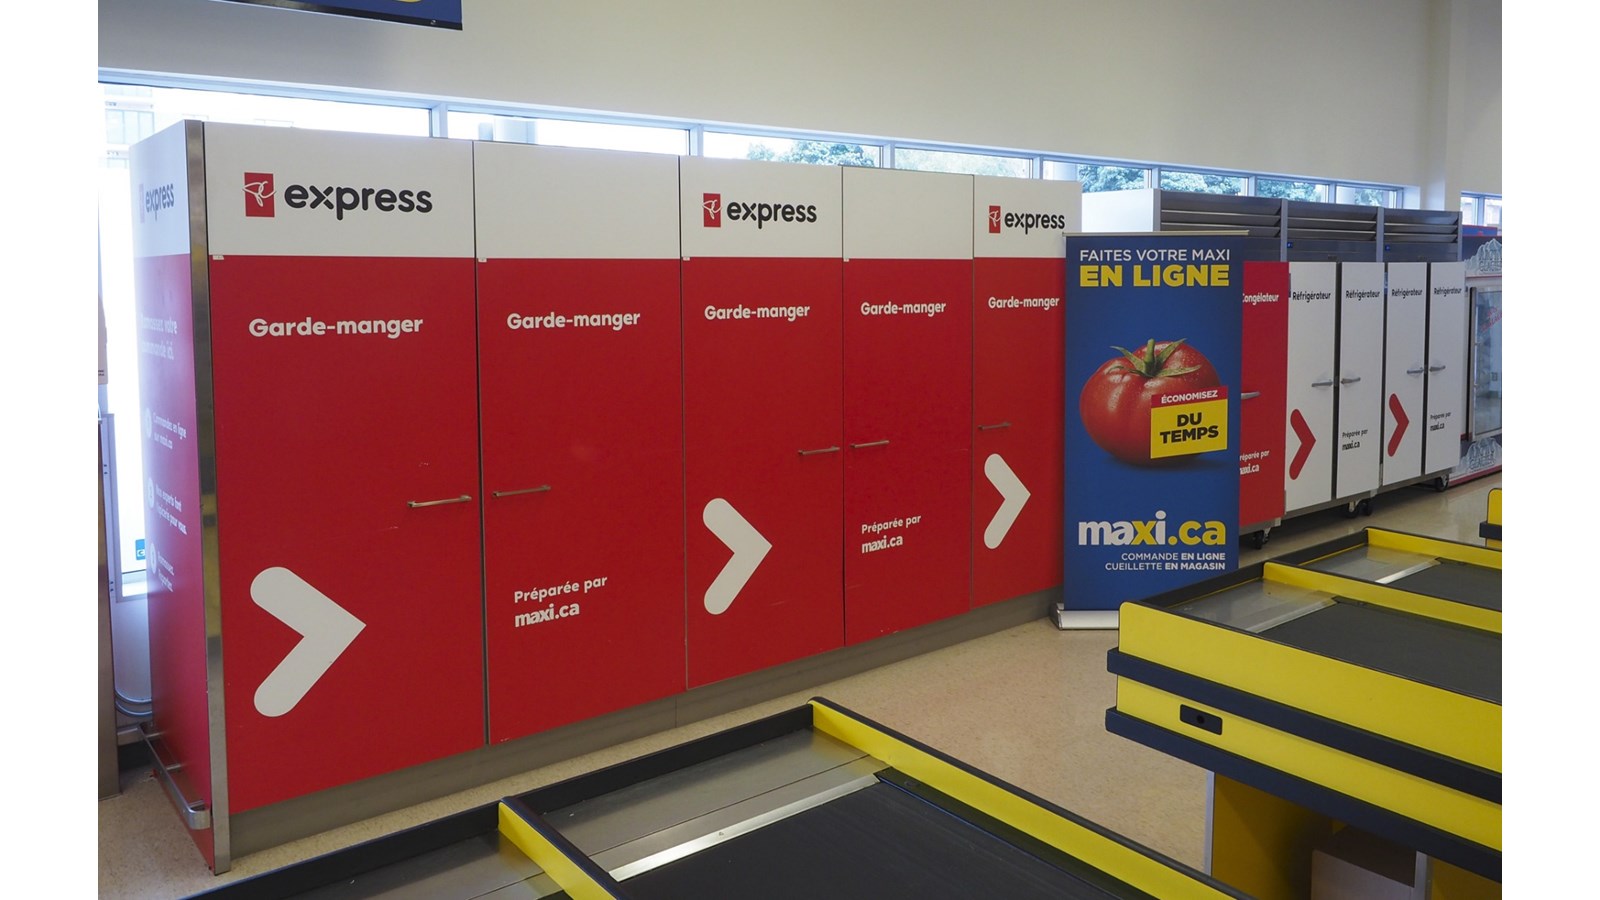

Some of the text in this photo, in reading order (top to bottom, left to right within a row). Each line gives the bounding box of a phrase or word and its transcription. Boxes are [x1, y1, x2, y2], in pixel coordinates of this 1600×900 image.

[145, 183, 175, 221] express
[284, 184, 433, 221] express
[727, 201, 818, 229] express
[1004, 212, 1066, 235] express
[1080, 249, 1231, 262] FAITES VOTRE MAXI
[1079, 264, 1230, 287] EN LIGNE
[1292, 291, 1331, 303] Réfrigérateur
[1345, 290, 1380, 302] Réfrigérateur
[1391, 288, 1423, 300] Réfrigérateur
[1434, 286, 1462, 298] Réfrigérateur
[861, 300, 947, 318] Garde-manger
[988, 295, 1060, 311] Garde-manger
[507, 311, 641, 331] Garde-manger
[704, 303, 811, 322] Garde-manger
[249, 316, 424, 340] Garde-manger
[1161, 389, 1219, 404] ÉCONOMISEZ
[1176, 411, 1203, 428] DU
[1430, 422, 1445, 431] maxi.ca
[1159, 425, 1219, 444] TEMPS
[1341, 428, 1369, 439] Préparée par
[1341, 440, 1361, 451] maxi.ca
[1239, 450, 1270, 463] réparée par
[862, 515, 922, 535] Préparée par
[1078, 510, 1227, 546] maxi.ca
[861, 535, 904, 554] maxi.ca
[1121, 552, 1226, 561] COMMANDE EN LIGNE
[1105, 562, 1226, 571] CUEILLETTE EN MAGASIN
[514, 576, 608, 604] Préparée par
[514, 603, 580, 628] maxi.ca
